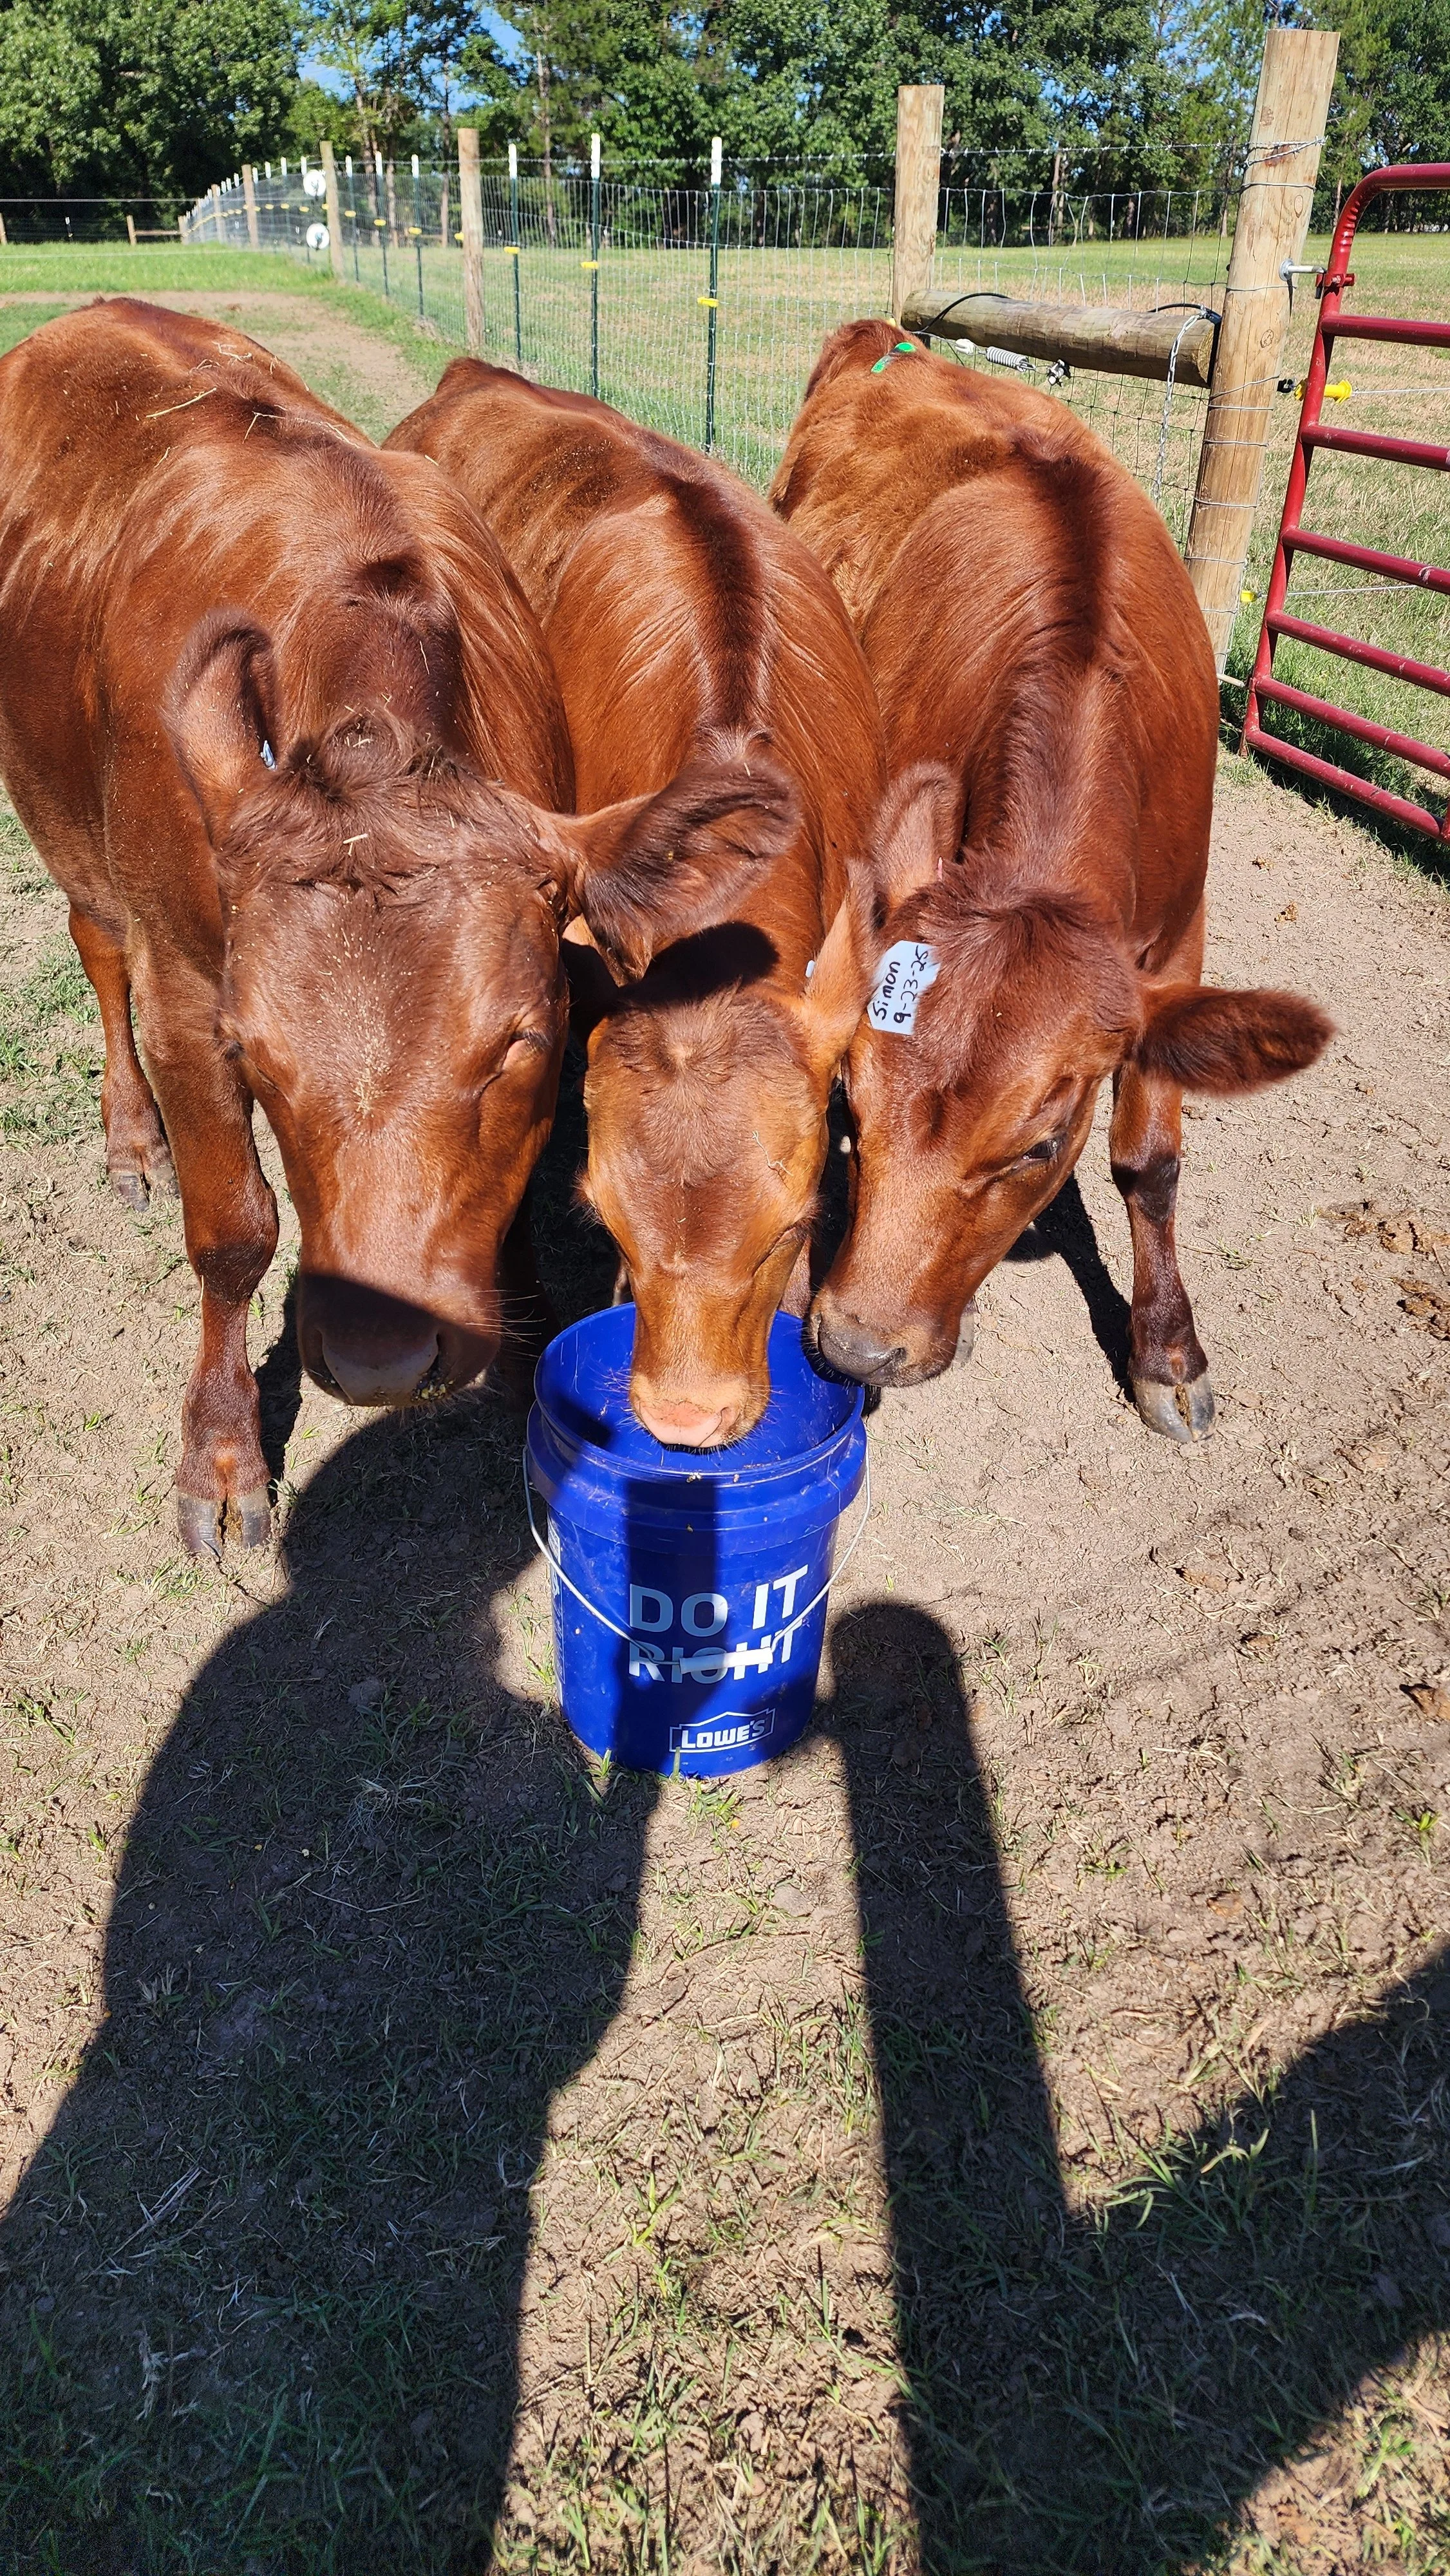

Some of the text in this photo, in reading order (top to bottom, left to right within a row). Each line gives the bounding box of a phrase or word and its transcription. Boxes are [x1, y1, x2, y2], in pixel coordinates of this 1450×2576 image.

[872, 961, 901, 1021] Simon
[629, 1564, 808, 1637] DO IT
[681, 1719, 766, 1748] LOWE'S
